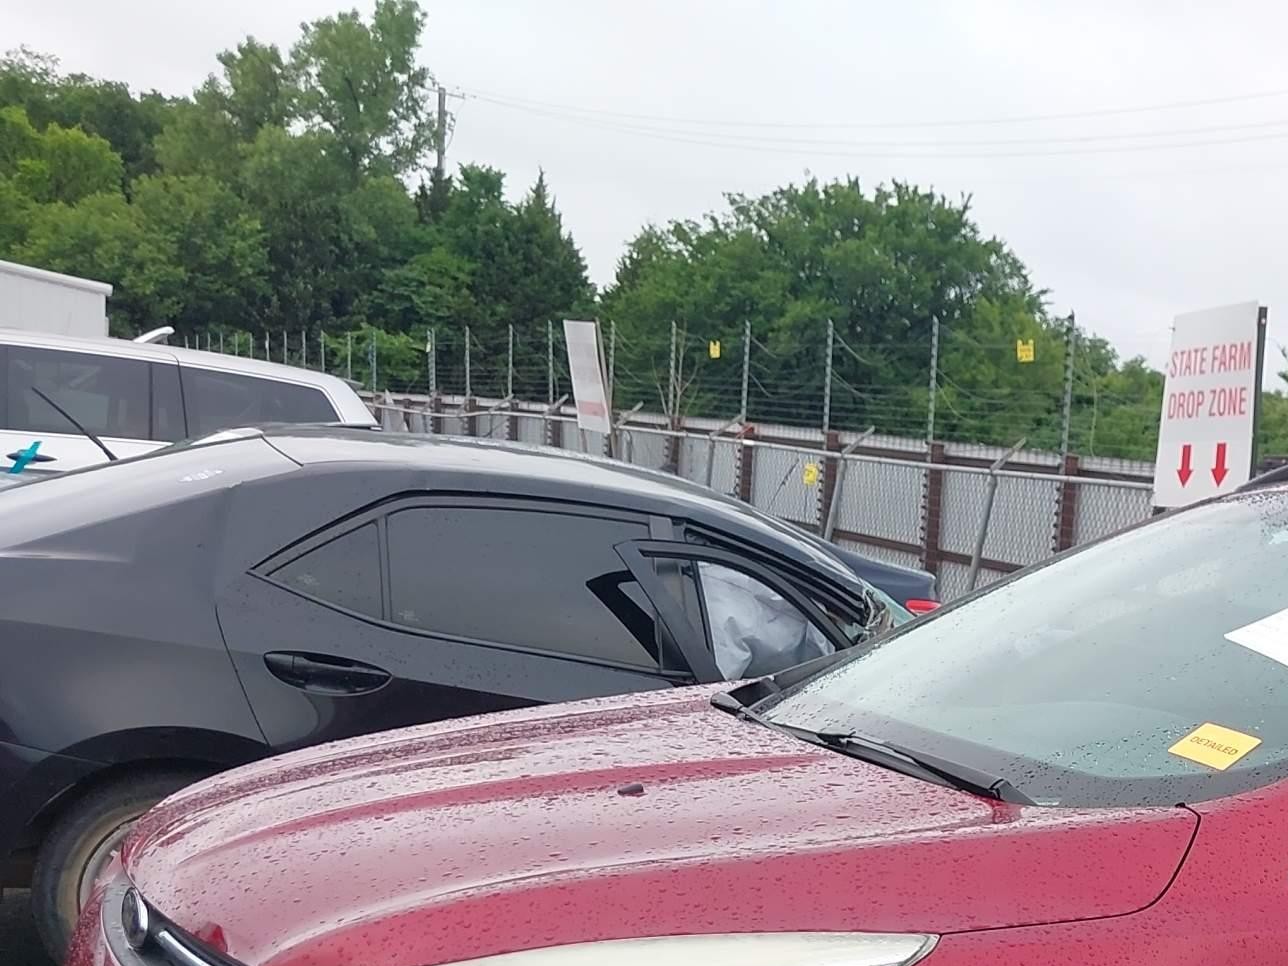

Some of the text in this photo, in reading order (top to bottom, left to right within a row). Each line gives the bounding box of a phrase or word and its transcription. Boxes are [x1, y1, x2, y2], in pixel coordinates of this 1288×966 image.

[1170, 342, 1252, 378] STATE FARM
[1168, 388, 1247, 419] DROP ZONE
[1190, 735, 1239, 756] DETAILED
